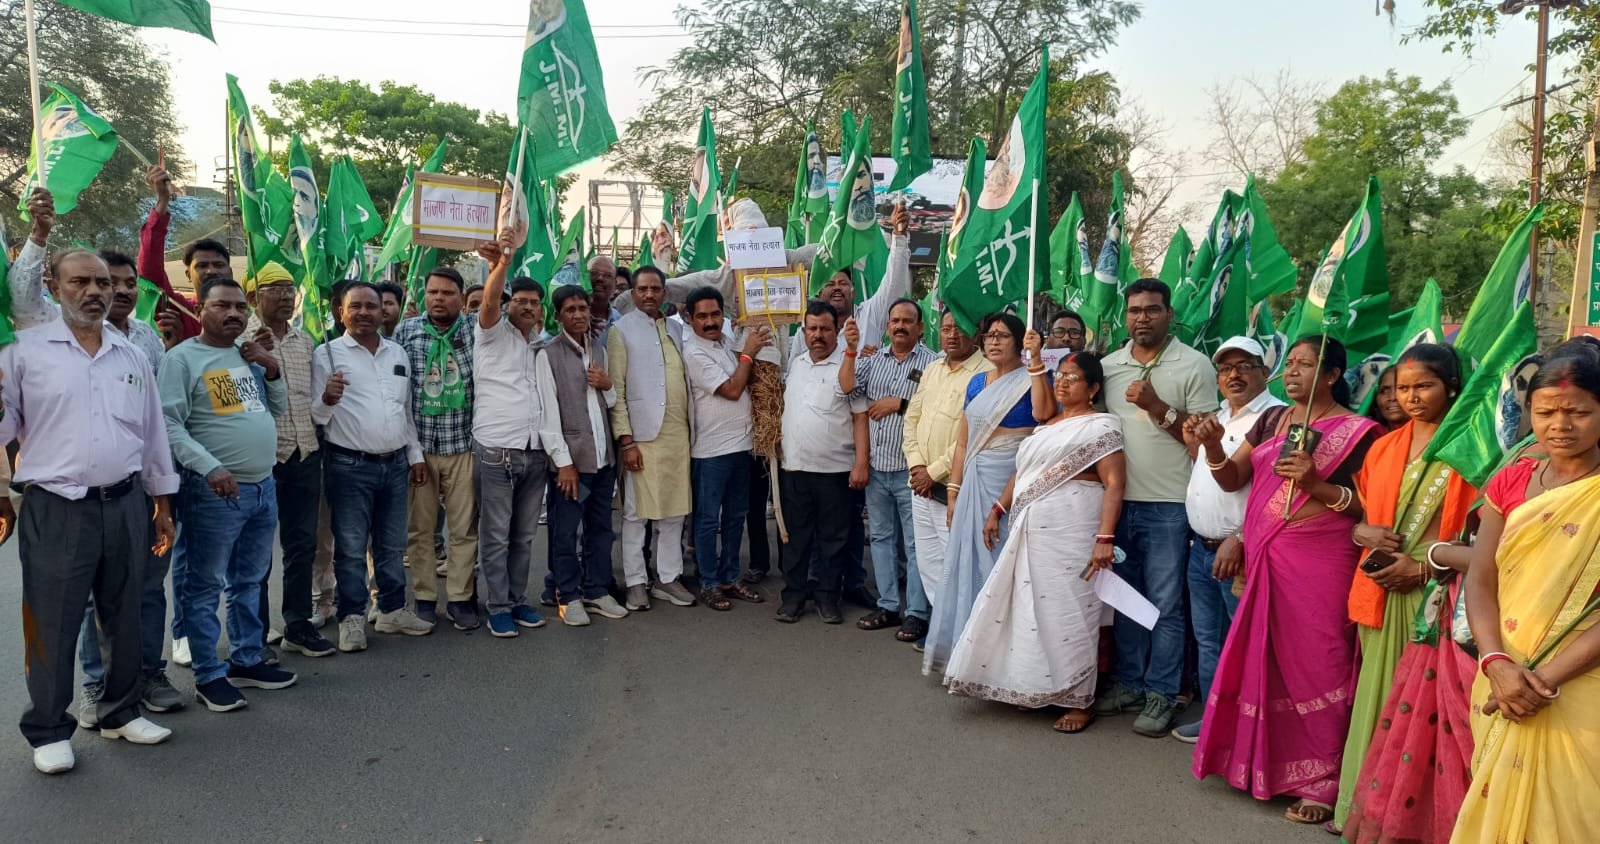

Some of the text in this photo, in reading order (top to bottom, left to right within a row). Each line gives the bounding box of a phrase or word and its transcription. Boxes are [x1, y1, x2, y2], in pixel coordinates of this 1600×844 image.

[539, 60, 568, 148] J.M.M.
[423, 193, 490, 225] भाजपा नेता हत्यारा
